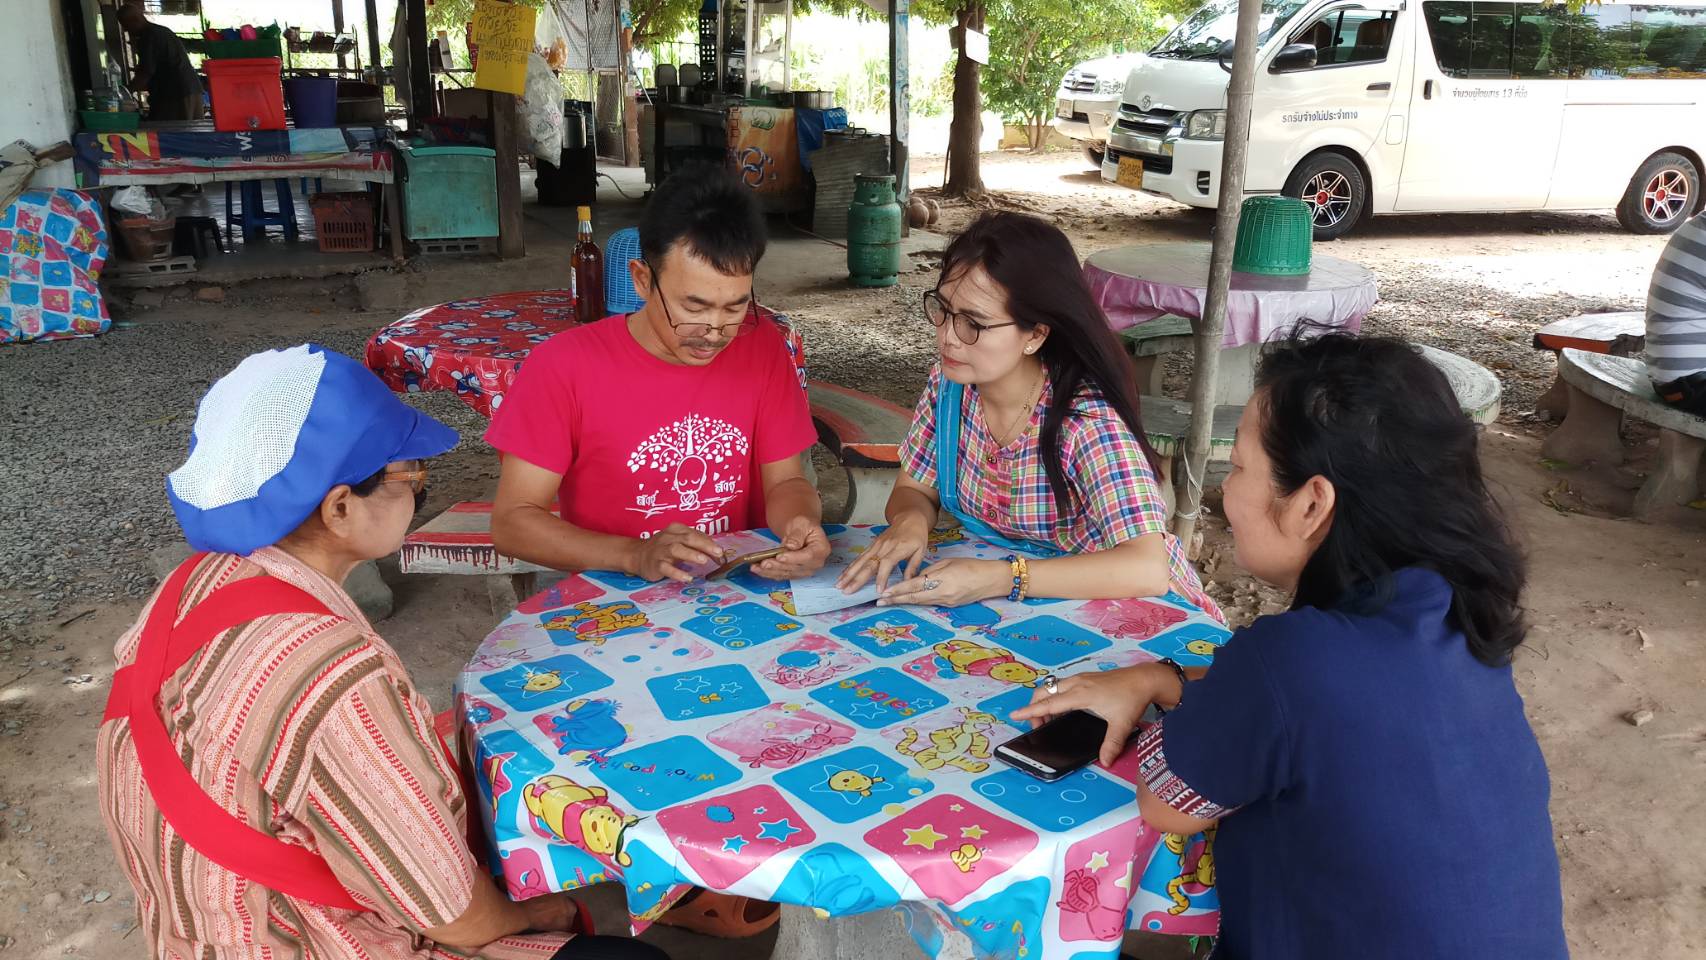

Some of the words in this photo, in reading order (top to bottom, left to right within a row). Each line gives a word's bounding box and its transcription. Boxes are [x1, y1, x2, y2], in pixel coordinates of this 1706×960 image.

[1502, 88, 1513, 98] 13
[1281, 108, 1358, 123] รถรับจ้างไม่ประจำทาง
